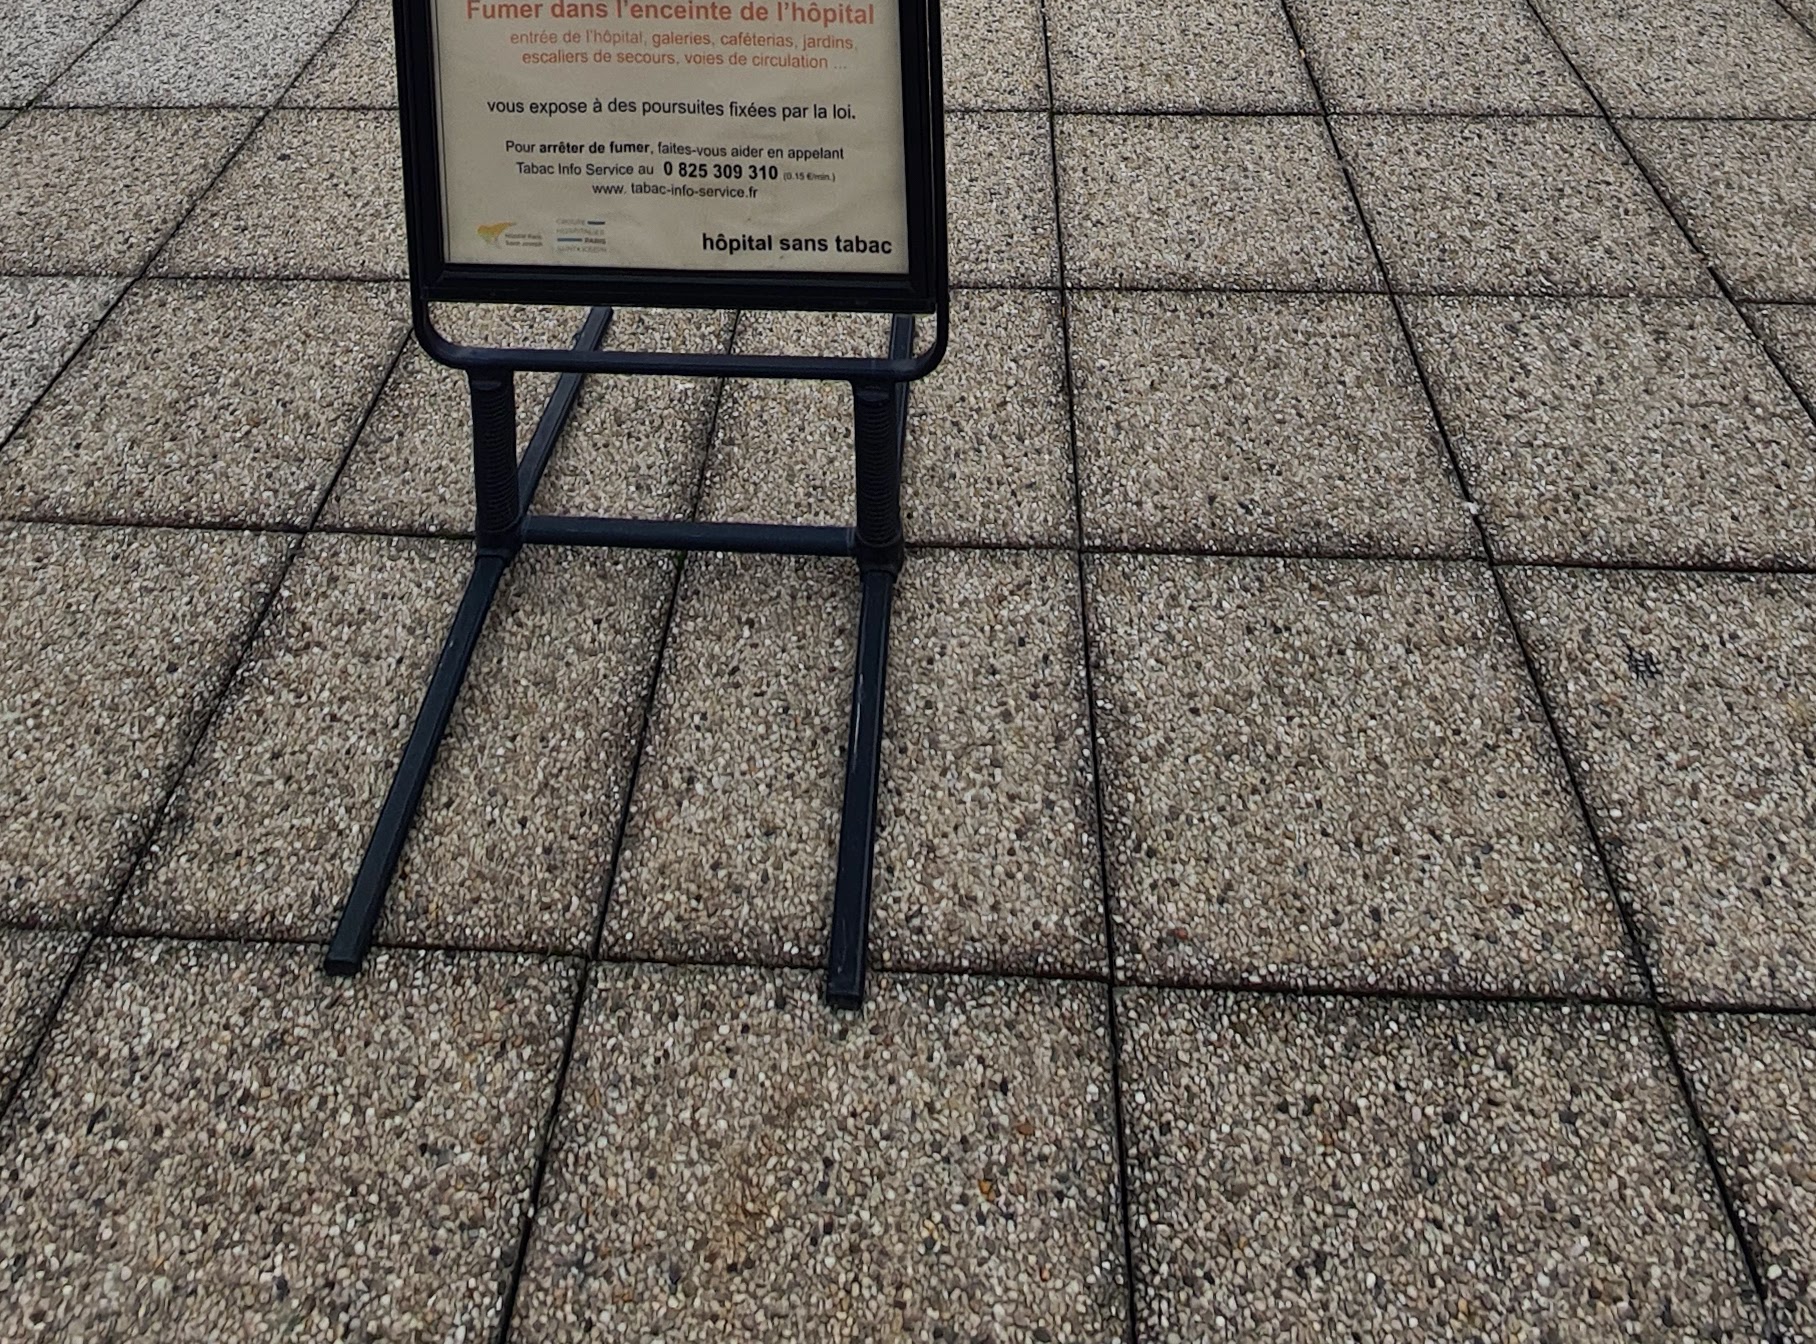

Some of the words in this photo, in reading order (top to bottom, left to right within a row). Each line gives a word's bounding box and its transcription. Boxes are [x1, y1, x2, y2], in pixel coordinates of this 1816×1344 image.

[466, 0, 544, 20] Fumer
[739, 1, 769, 22] de
[777, 1, 874, 28] l'hôpital
[510, 29, 558, 45] entrée
[562, 29, 582, 44] de
[651, 31, 715, 49] galeries,
[521, 49, 589, 64] escaliers
[592, 49, 612, 64] de
[683, 53, 725, 65] voies
[728, 51, 748, 66] de
[751, 53, 828, 69] circulation
[487, 101, 524, 114] vous
[529, 101, 588, 118] expose
[592, 97, 603, 114] à
[607, 97, 637, 113] des
[641, 99, 725, 117] poursuites
[728, 100, 777, 118] fixées
[781, 106, 809, 122] par
[813, 103, 828, 119] la
[832, 103, 856, 120] loi.
[505, 140, 536, 154] Pour
[539, 141, 585, 154] arrêter
[588, 141, 606, 154] de
[609, 140, 654, 155] fumer,
[657, 141, 728, 158] faites-vous
[730, 144, 765, 159] aider
[766, 148, 784, 159] en
[787, 146, 845, 162] appelant
[515, 161, 555, 175] Tabac
[558, 162, 582, 176] Info
[585, 162, 634, 176] Service
[637, 165, 654, 176] au
[663, 160, 673, 177] 0
[678, 161, 708, 179] 825
[712, 163, 743, 180] 309
[748, 164, 779, 181] 310
[591, 184, 627, 196] www.
[630, 181, 759, 199] tabac-info-service.fr
[702, 233, 773, 255] hôpital
[779, 237, 829, 252] sans
[834, 234, 893, 255] tabac
